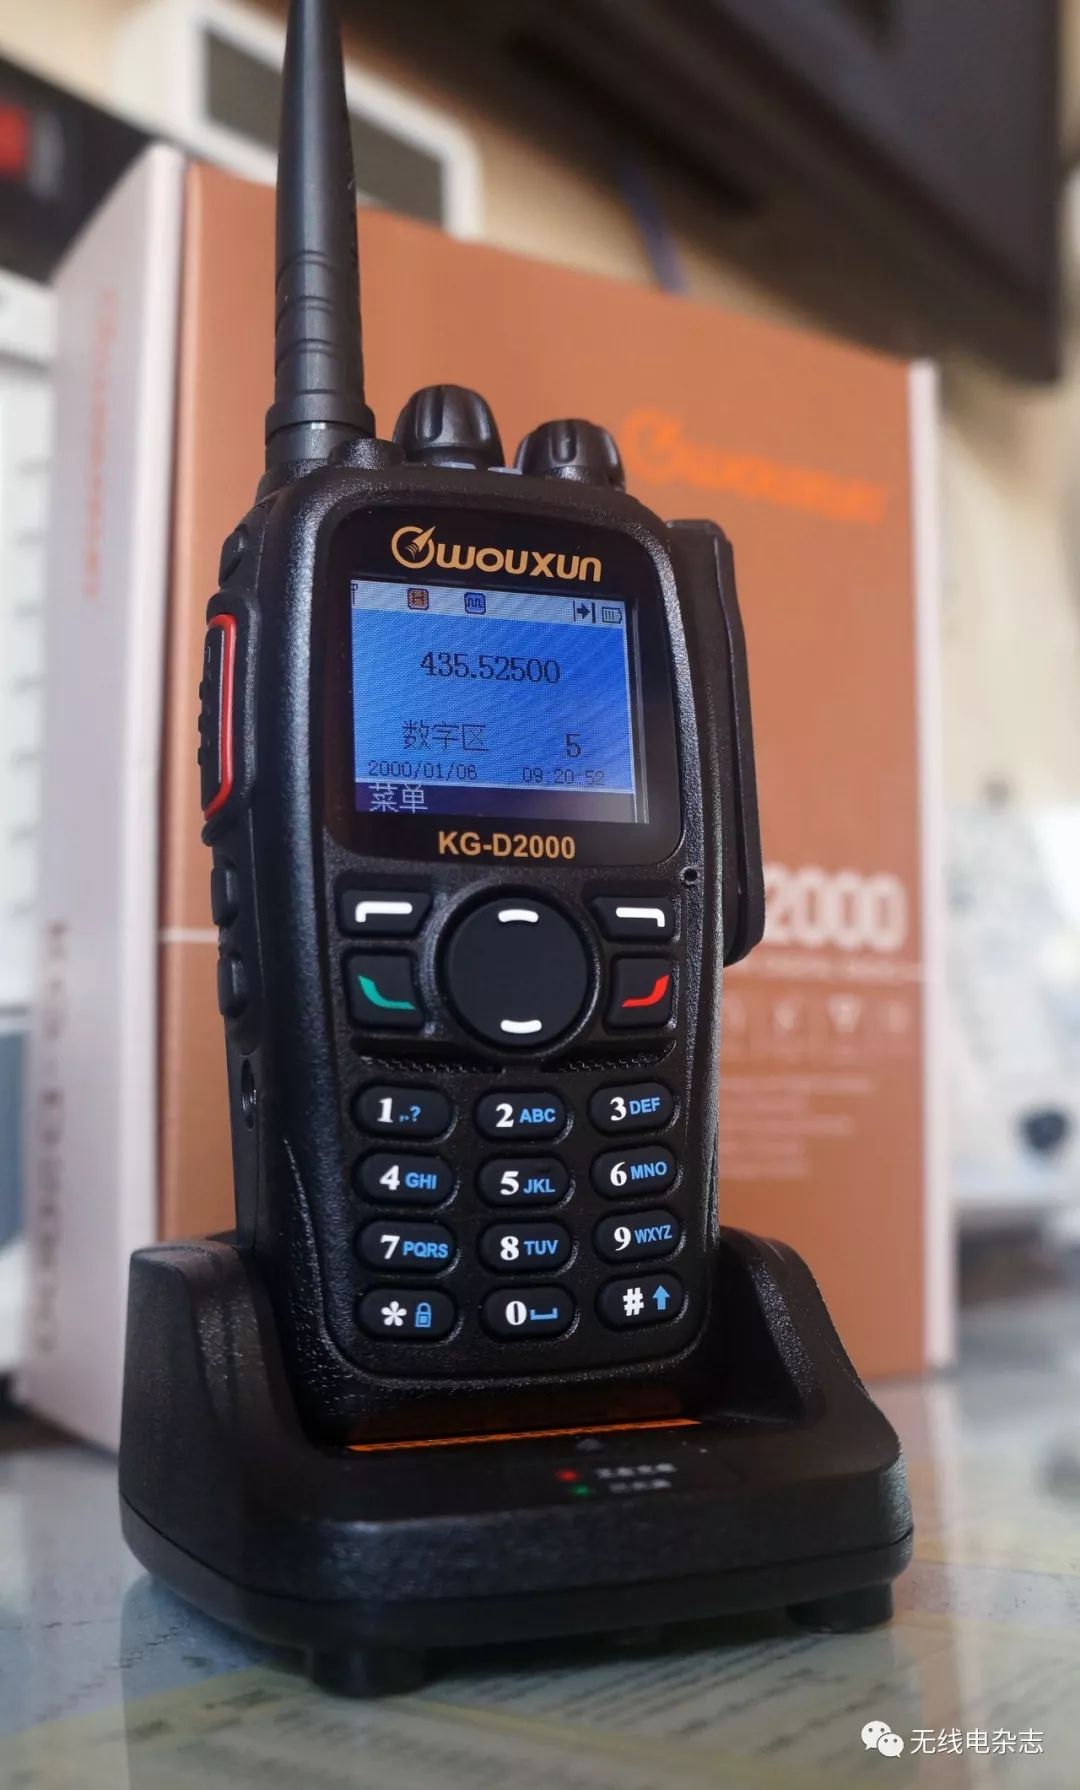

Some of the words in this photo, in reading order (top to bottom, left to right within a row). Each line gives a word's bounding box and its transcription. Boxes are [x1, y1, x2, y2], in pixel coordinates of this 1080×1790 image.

[420, 651, 561, 684] 435.52500
[403, 720, 489, 752] 数字区
[565, 733, 581, 758] 5
[368, 782, 428, 813] 菜单
[438, 831, 576, 860] KG-D2000
[377, 1097, 394, 1123] 1
[495, 1103, 514, 1128] 2
[519, 1108, 556, 1123] ABC
[610, 1096, 627, 1121] 3
[629, 1097, 661, 1115] DEF
[379, 1165, 400, 1191] 4
[404, 1172, 437, 1190] GHI
[500, 1171, 519, 1195] 5
[523, 1179, 556, 1194] JKL
[610, 1161, 627, 1187] 6
[630, 1161, 667, 1180] MNO
[379, 1235, 400, 1260] 7
[402, 1241, 449, 1258] PQRS
[500, 1236, 519, 1261] 8
[523, 1239, 559, 1256] TUV
[614, 1226, 631, 1251] 9
[634, 1225, 673, 1244] WXYZ
[505, 1300, 527, 1326] 0
